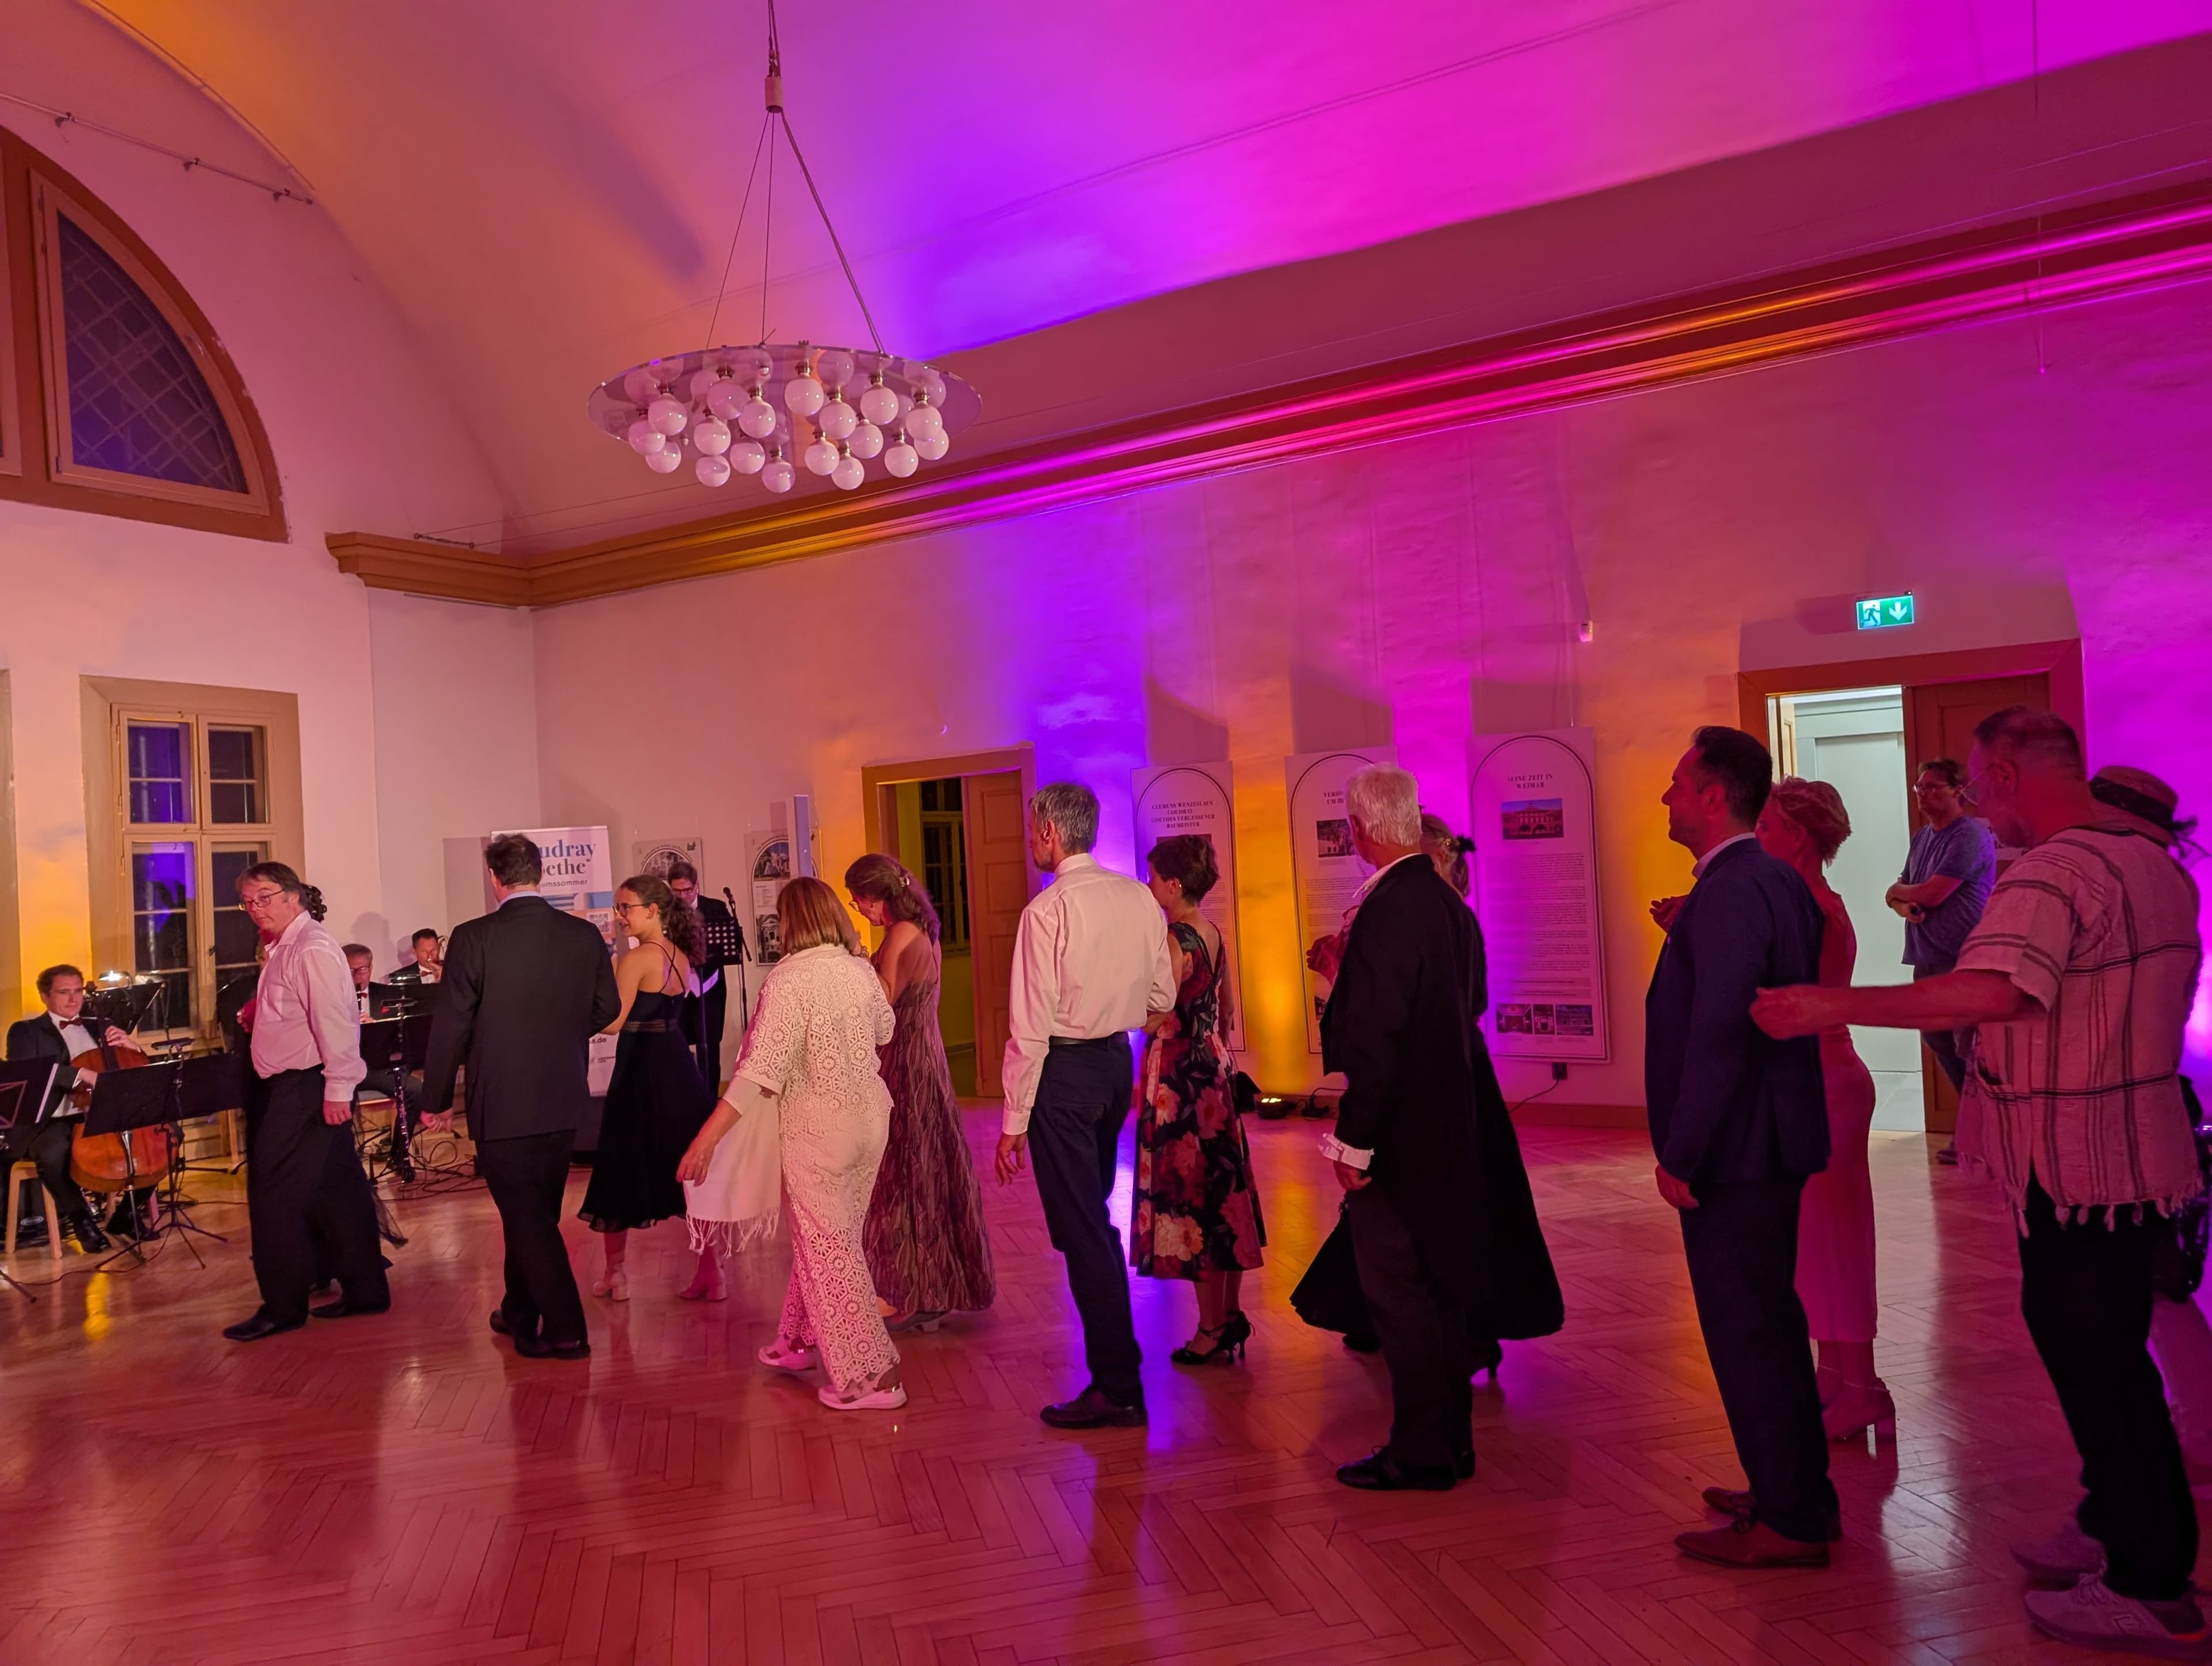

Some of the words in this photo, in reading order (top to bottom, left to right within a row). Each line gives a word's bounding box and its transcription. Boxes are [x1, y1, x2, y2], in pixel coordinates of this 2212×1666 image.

[537, 839, 597, 862] udray
[542, 858, 586, 876] ethe
[542, 879, 588, 888] mssommer
